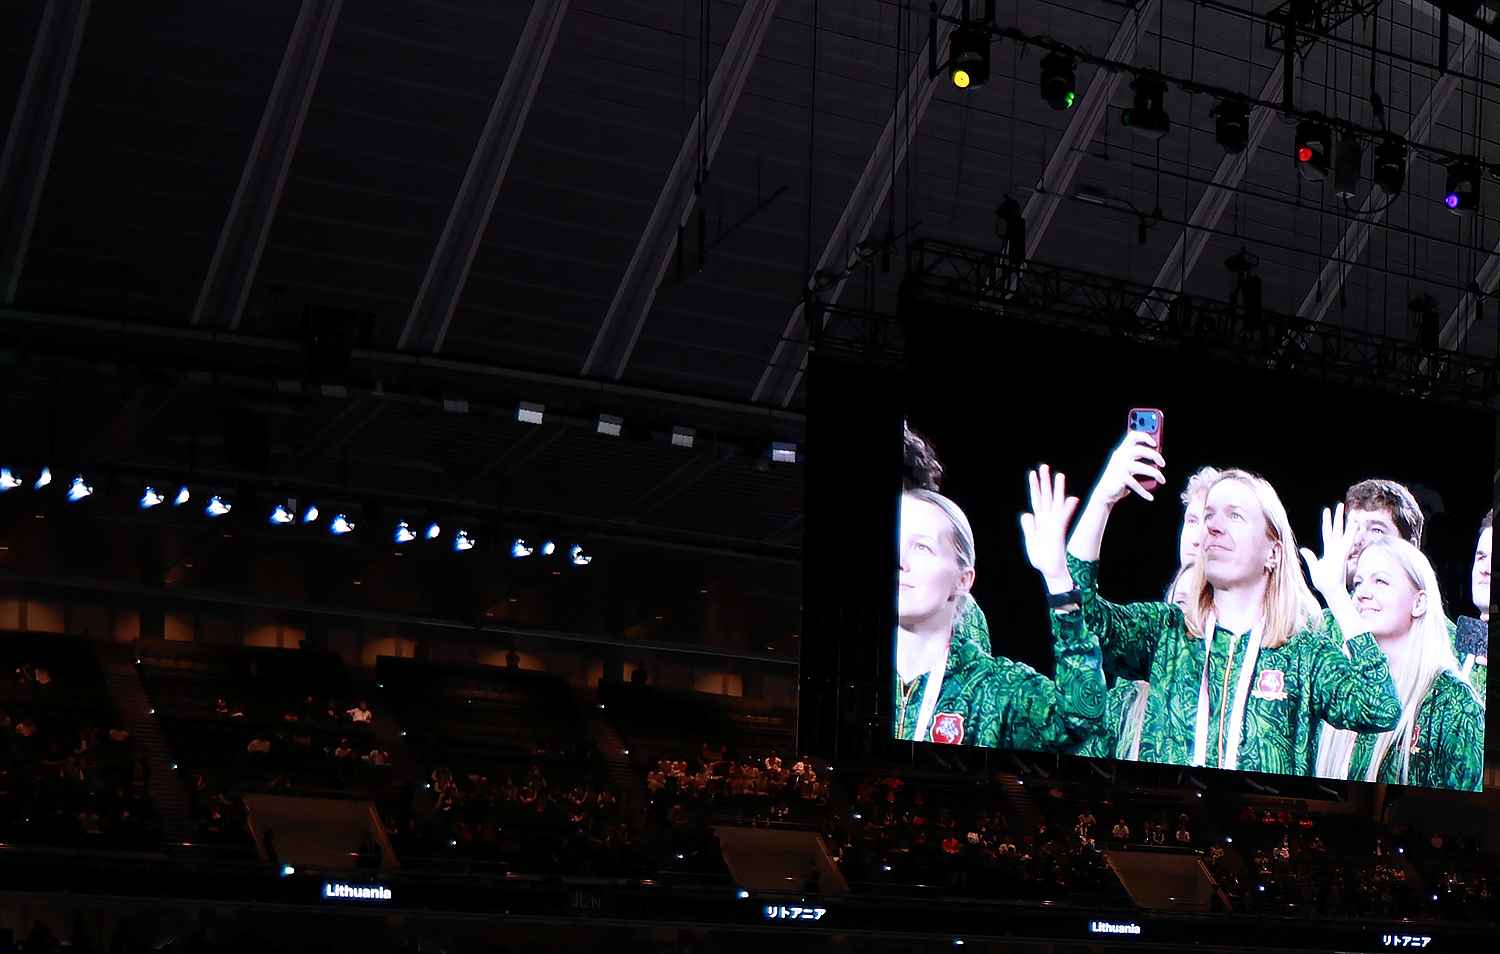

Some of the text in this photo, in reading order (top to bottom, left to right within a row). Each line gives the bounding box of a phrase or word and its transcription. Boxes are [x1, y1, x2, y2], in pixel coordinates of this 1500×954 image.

[327, 884, 392, 899] Lithuania
[767, 905, 826, 920] リトアニア
[1092, 922, 1141, 935] Lithuania
[1384, 935, 1432, 948] リトアニア
